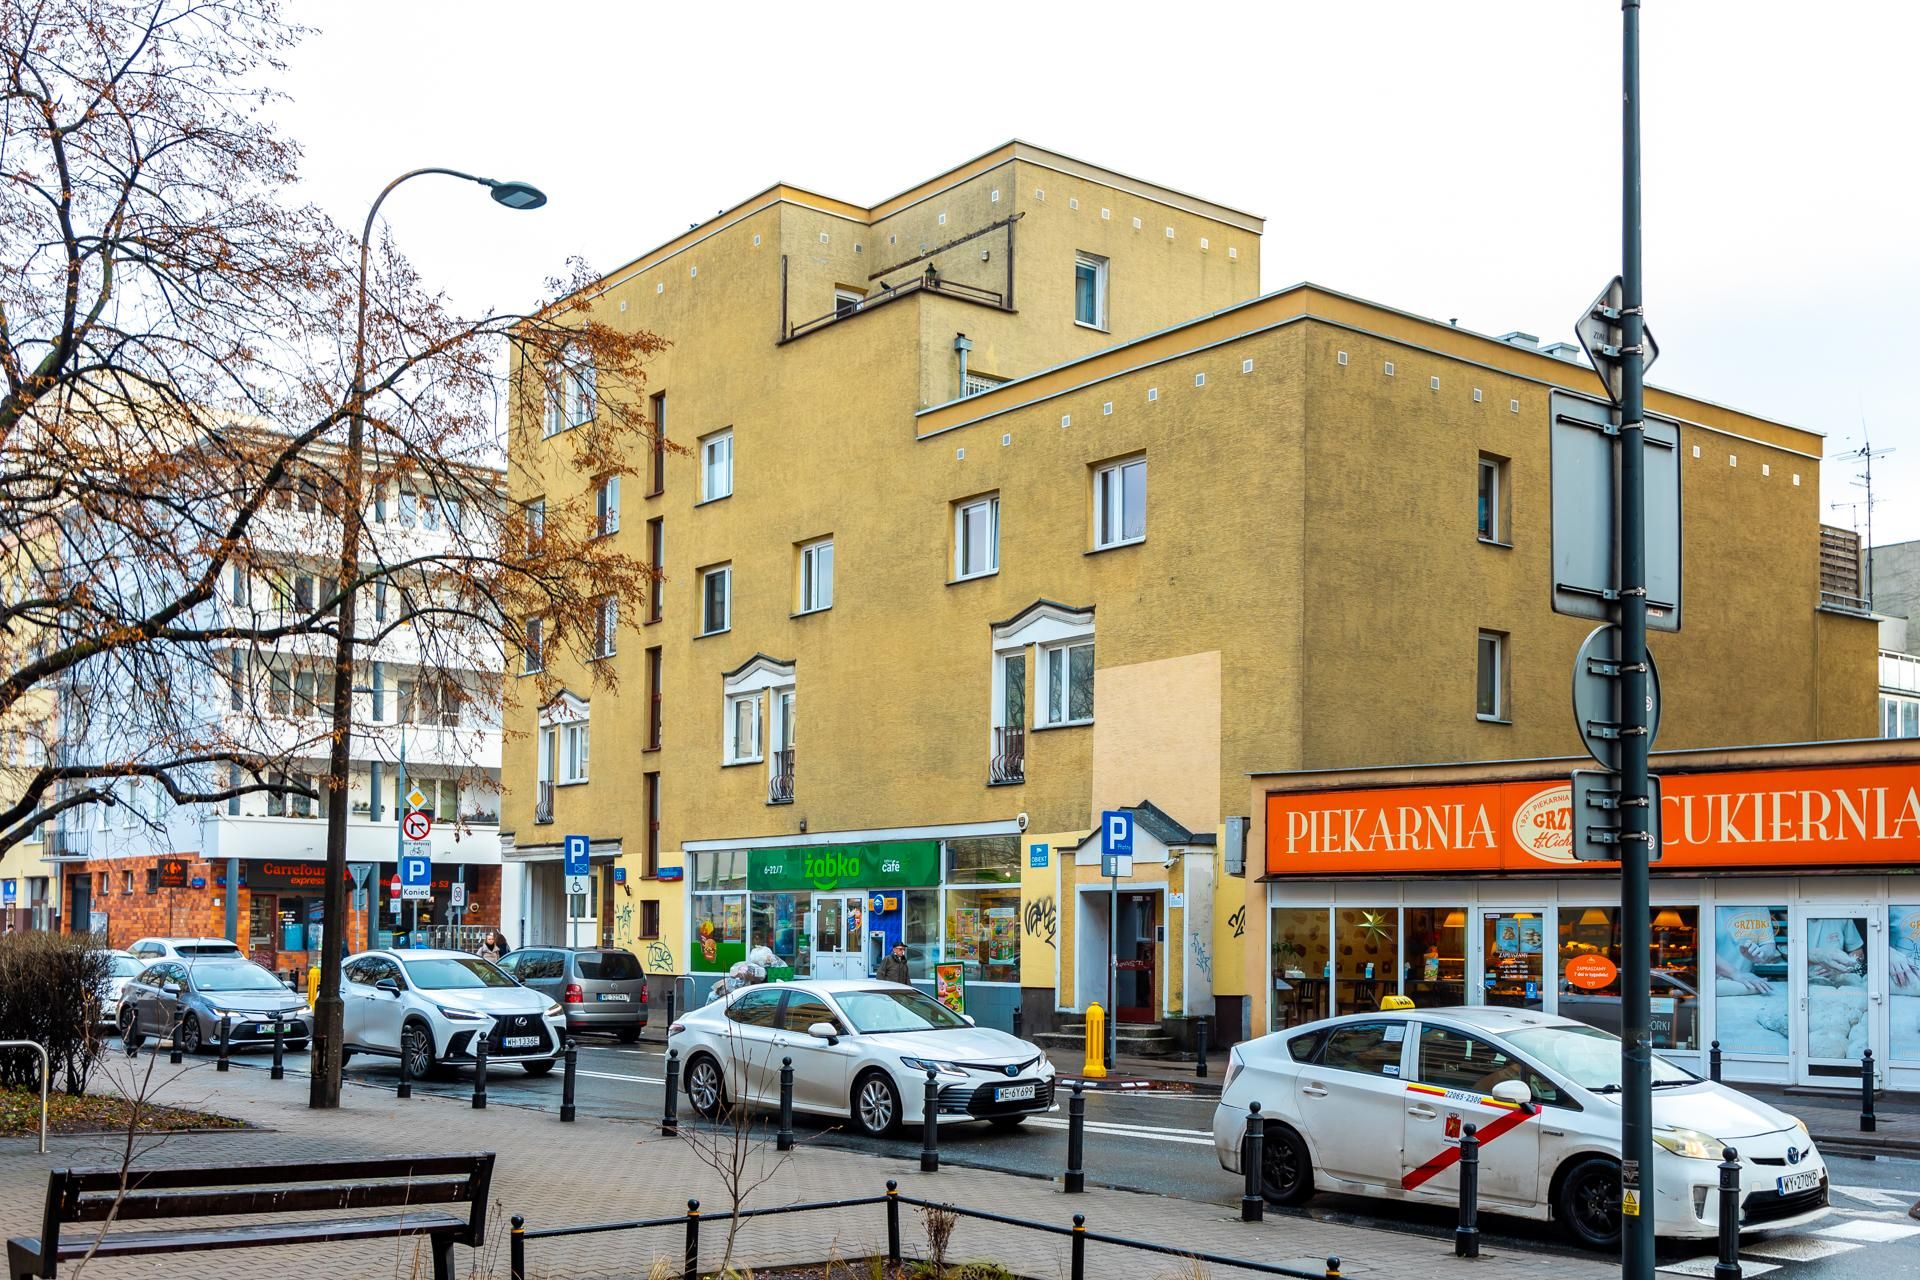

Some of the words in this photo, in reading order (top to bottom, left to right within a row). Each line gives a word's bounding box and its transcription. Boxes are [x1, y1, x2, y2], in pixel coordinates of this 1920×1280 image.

[1532, 794, 1570, 811] PIEKARNIA
[1109, 816, 1127, 850] P
[1286, 803, 1498, 854] PIEKARNIA
[571, 839, 585, 864] P
[263, 863, 326, 877] Carrefour
[409, 860, 425, 882] P
[804, 852, 861, 879] żabka
[881, 859, 900, 873] café
[290, 878, 326, 886] express
